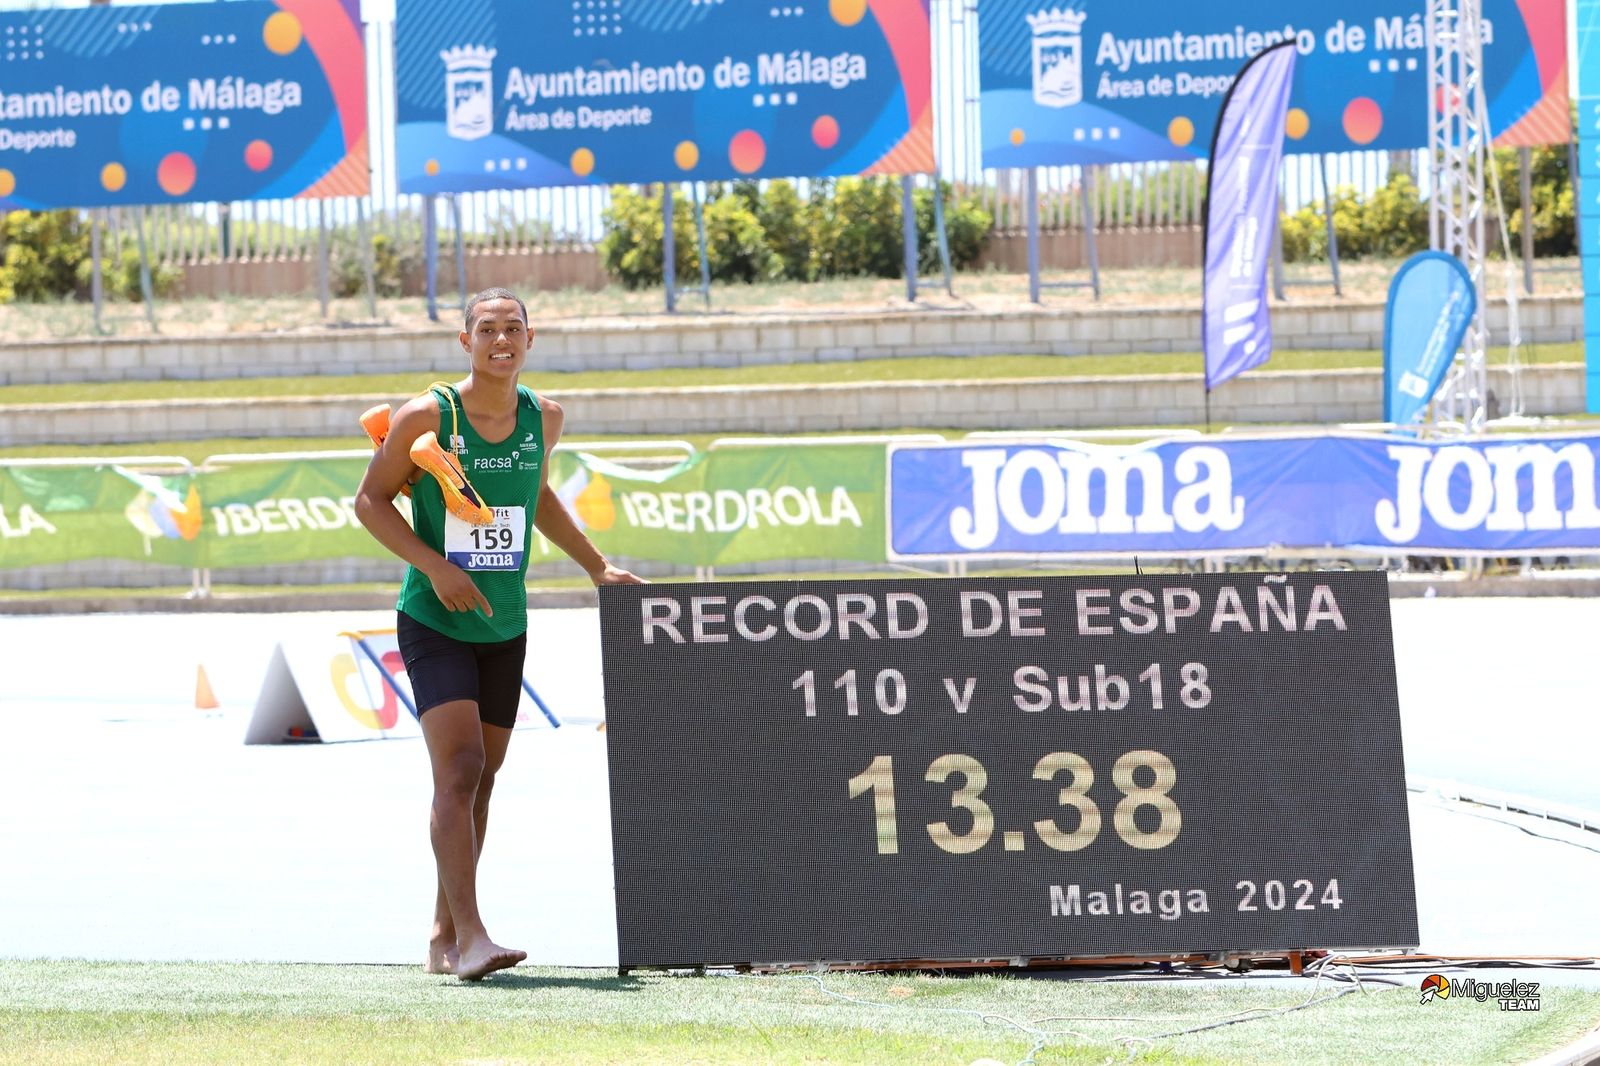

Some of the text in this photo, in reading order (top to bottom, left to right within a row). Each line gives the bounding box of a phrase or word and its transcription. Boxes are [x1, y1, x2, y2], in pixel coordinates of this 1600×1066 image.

[1325, 19, 1366, 54] de
[141, 80, 180, 112] de
[188, 75, 302, 114] Málaga
[504, 50, 866, 106] Ayuntamiento de Málaga
[1097, 71, 1145, 98] Área
[1147, 74, 1173, 96] de
[504, 104, 653, 131] Área de Deporte
[0, 128, 76, 153] Deporte
[621, 485, 862, 533] IBERDROLA
[470, 528, 513, 550] 159
[640, 575, 1348, 645] RECORD DE ESPAÑA
[792, 662, 1212, 718] 110 v Sub18
[848, 750, 1182, 856] 13.38
[1050, 879, 1343, 922] Malaga 2024
